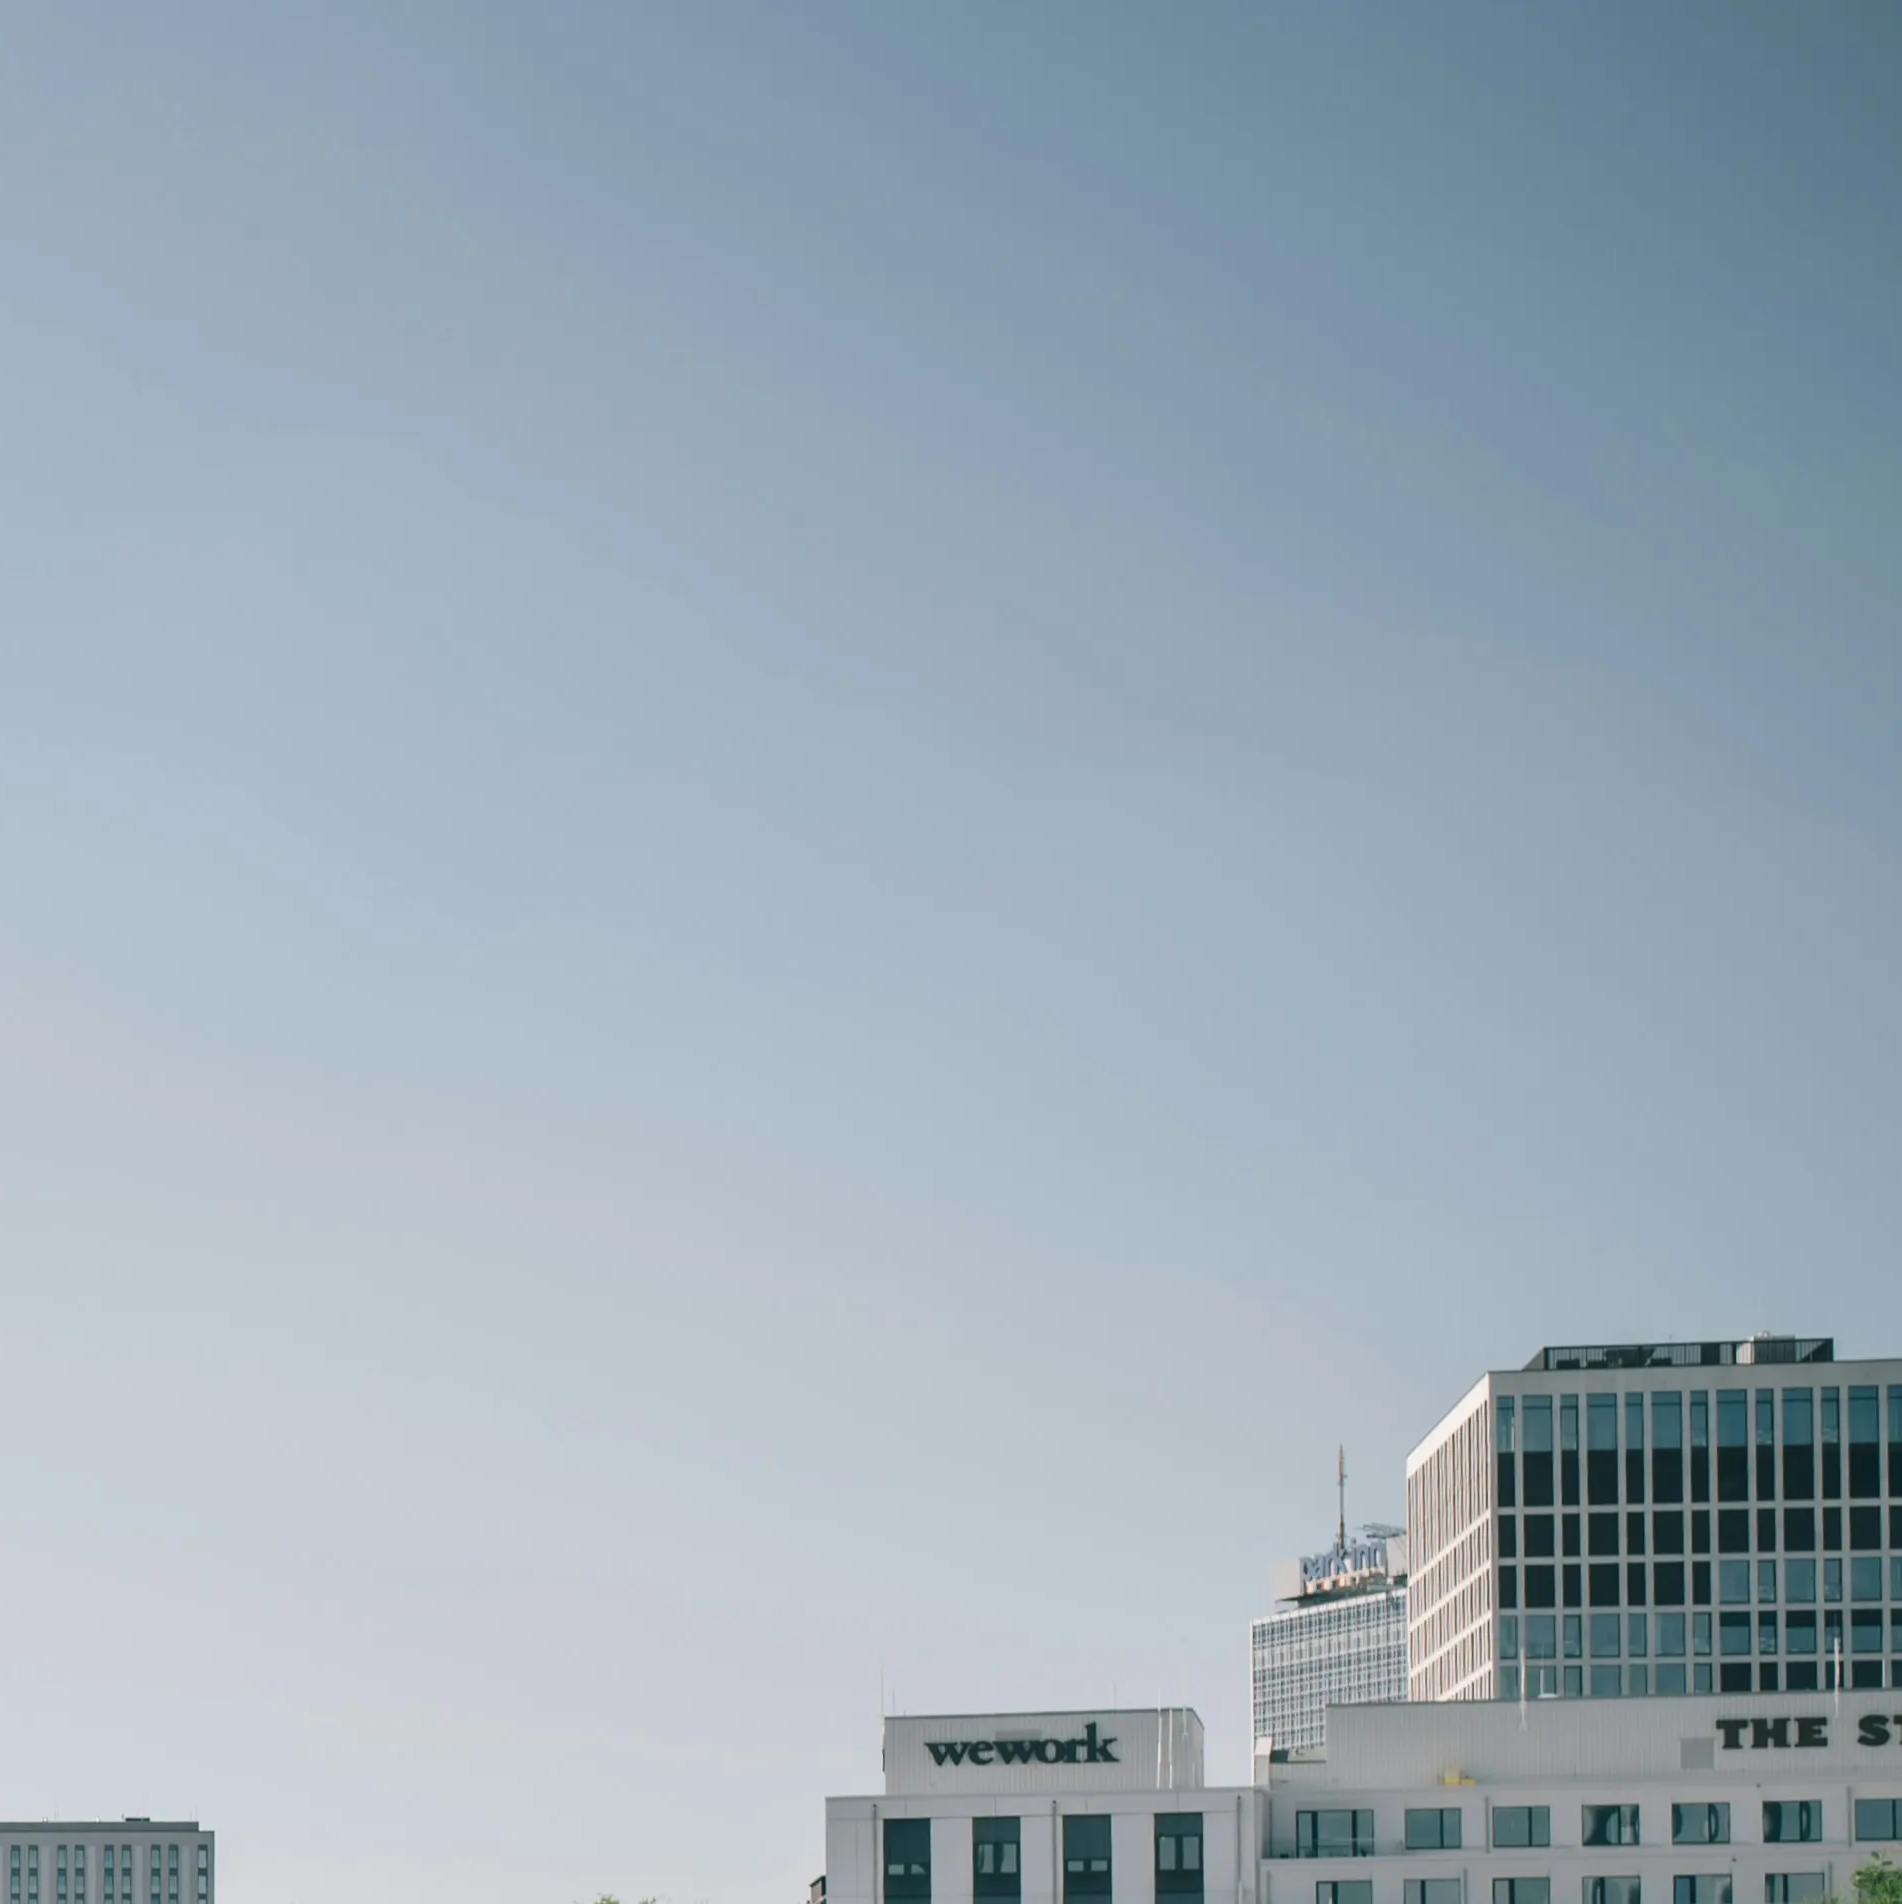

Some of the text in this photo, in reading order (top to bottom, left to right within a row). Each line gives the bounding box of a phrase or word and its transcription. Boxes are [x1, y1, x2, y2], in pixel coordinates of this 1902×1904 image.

[1299, 1538, 1387, 1594] park inn
[924, 1721, 1120, 1767] wework
[1715, 1714, 1902, 1749] THE S
